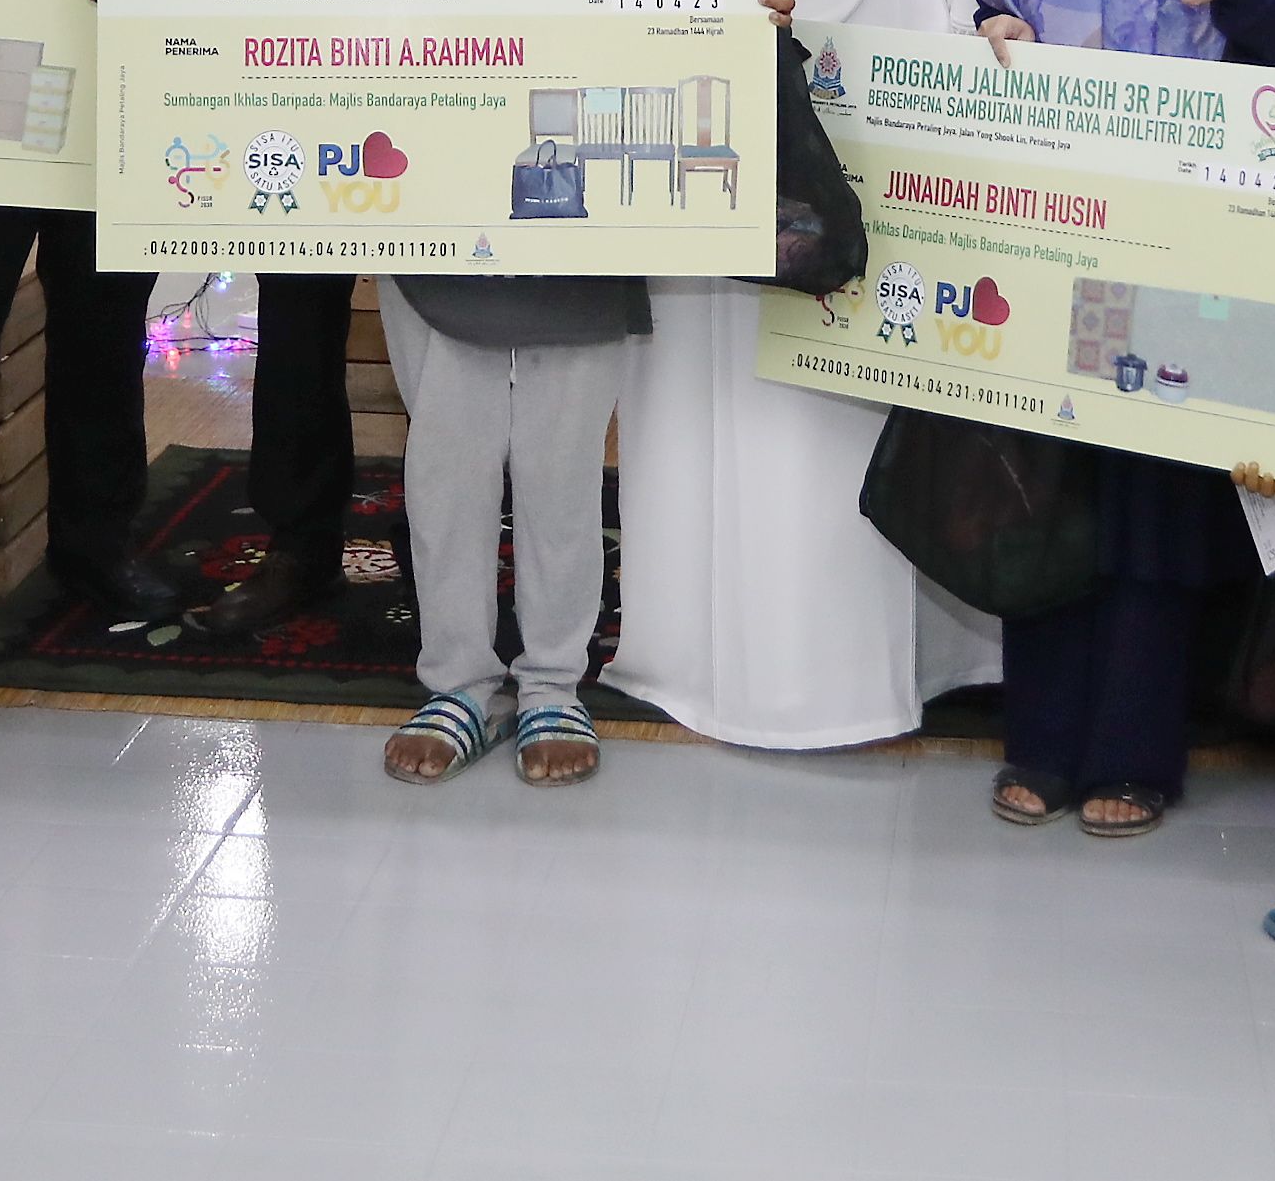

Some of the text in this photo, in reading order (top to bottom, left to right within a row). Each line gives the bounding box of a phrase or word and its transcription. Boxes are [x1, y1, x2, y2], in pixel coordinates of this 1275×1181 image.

[165, 47, 219, 55] PENERIMA
[245, 37, 523, 66] ROZITA BINTI A.RAHMAN
[163, 92, 506, 110] Sumbangan Ikhlas Daripada: Majlis Bandaraya Petaling Jaya
[870, 54, 1225, 123] PROGRAM JALINAN KASIH 3R PJKITA
[868, 88, 1224, 149] BERSEMPENA SAMBUTAN HARI RAYA AIDILFITRI 2023
[248, 153, 300, 170] SISA
[318, 143, 360, 176] PJ
[321, 180, 399, 213] YOU
[883, 170, 1106, 229] JUNAIDAH BINTI HUSIN
[879, 281, 921, 304] SISA
[934, 281, 971, 317] PJ
[936, 319, 1000, 356] YOU
